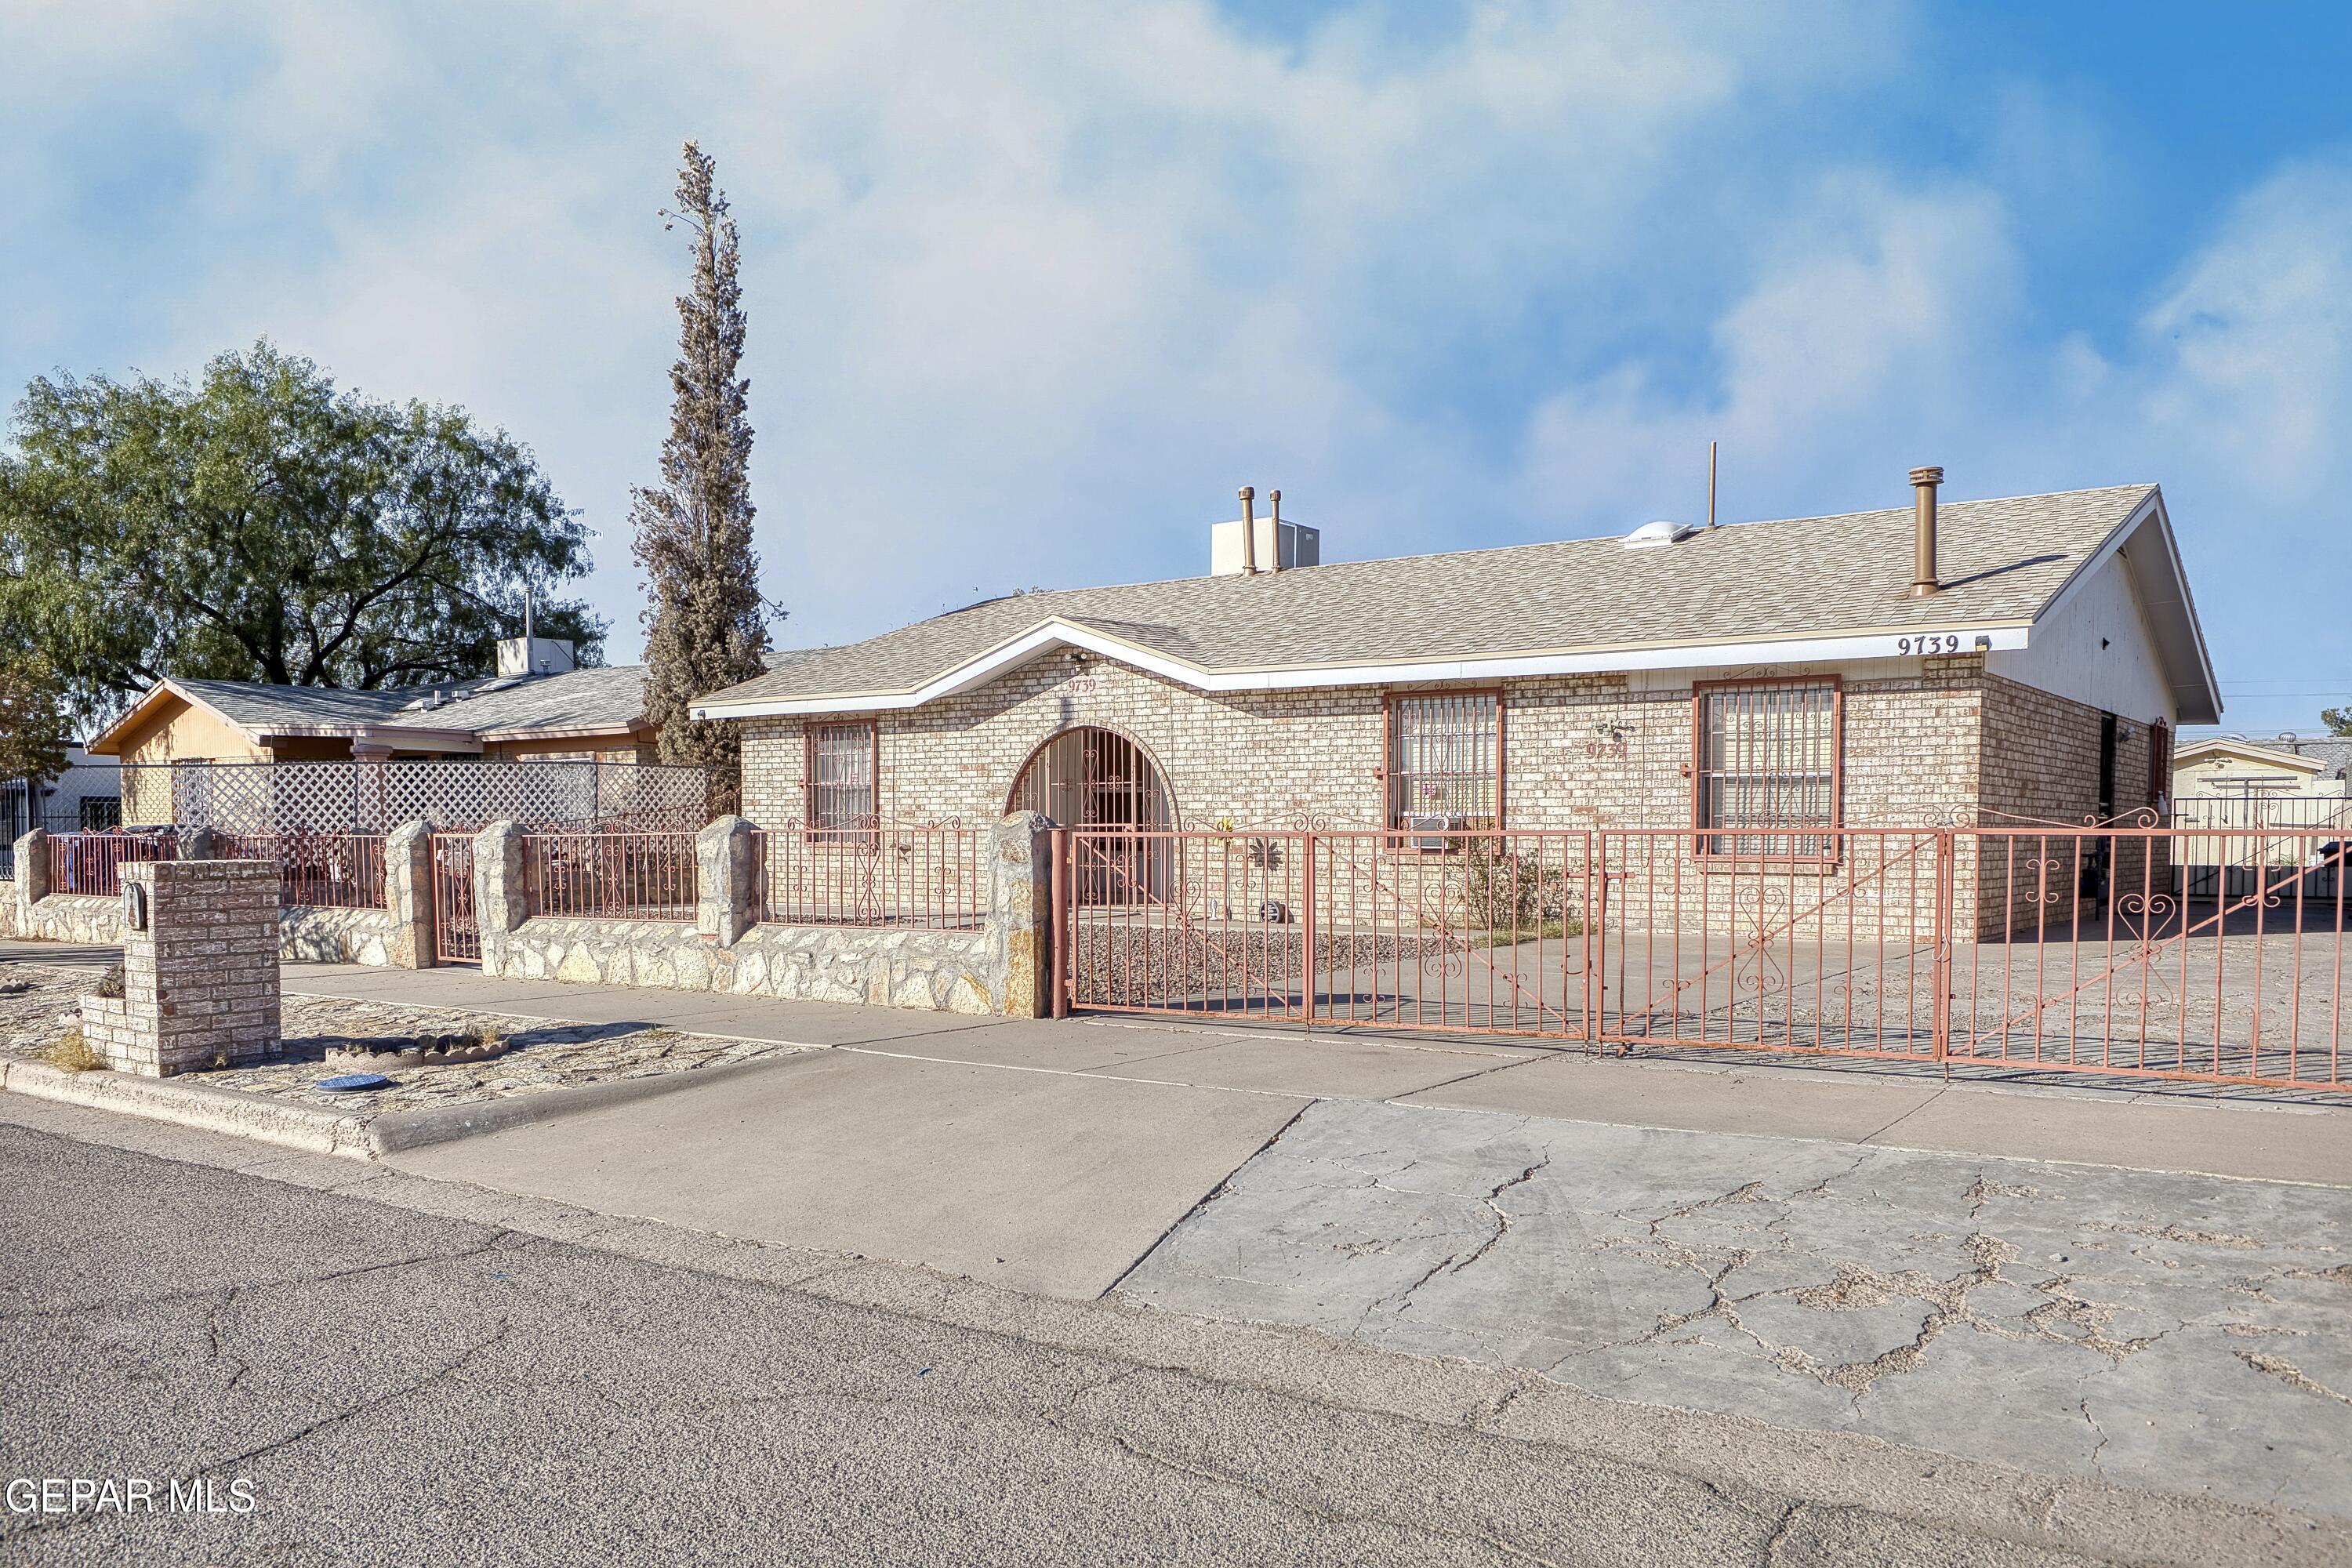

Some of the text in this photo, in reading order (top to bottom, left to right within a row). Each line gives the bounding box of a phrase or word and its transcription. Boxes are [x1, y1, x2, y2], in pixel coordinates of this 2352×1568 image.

[1898, 635, 1958, 655] 9739
[1069, 679, 1096, 692] 9739
[1587, 741, 1627, 759] 9739
